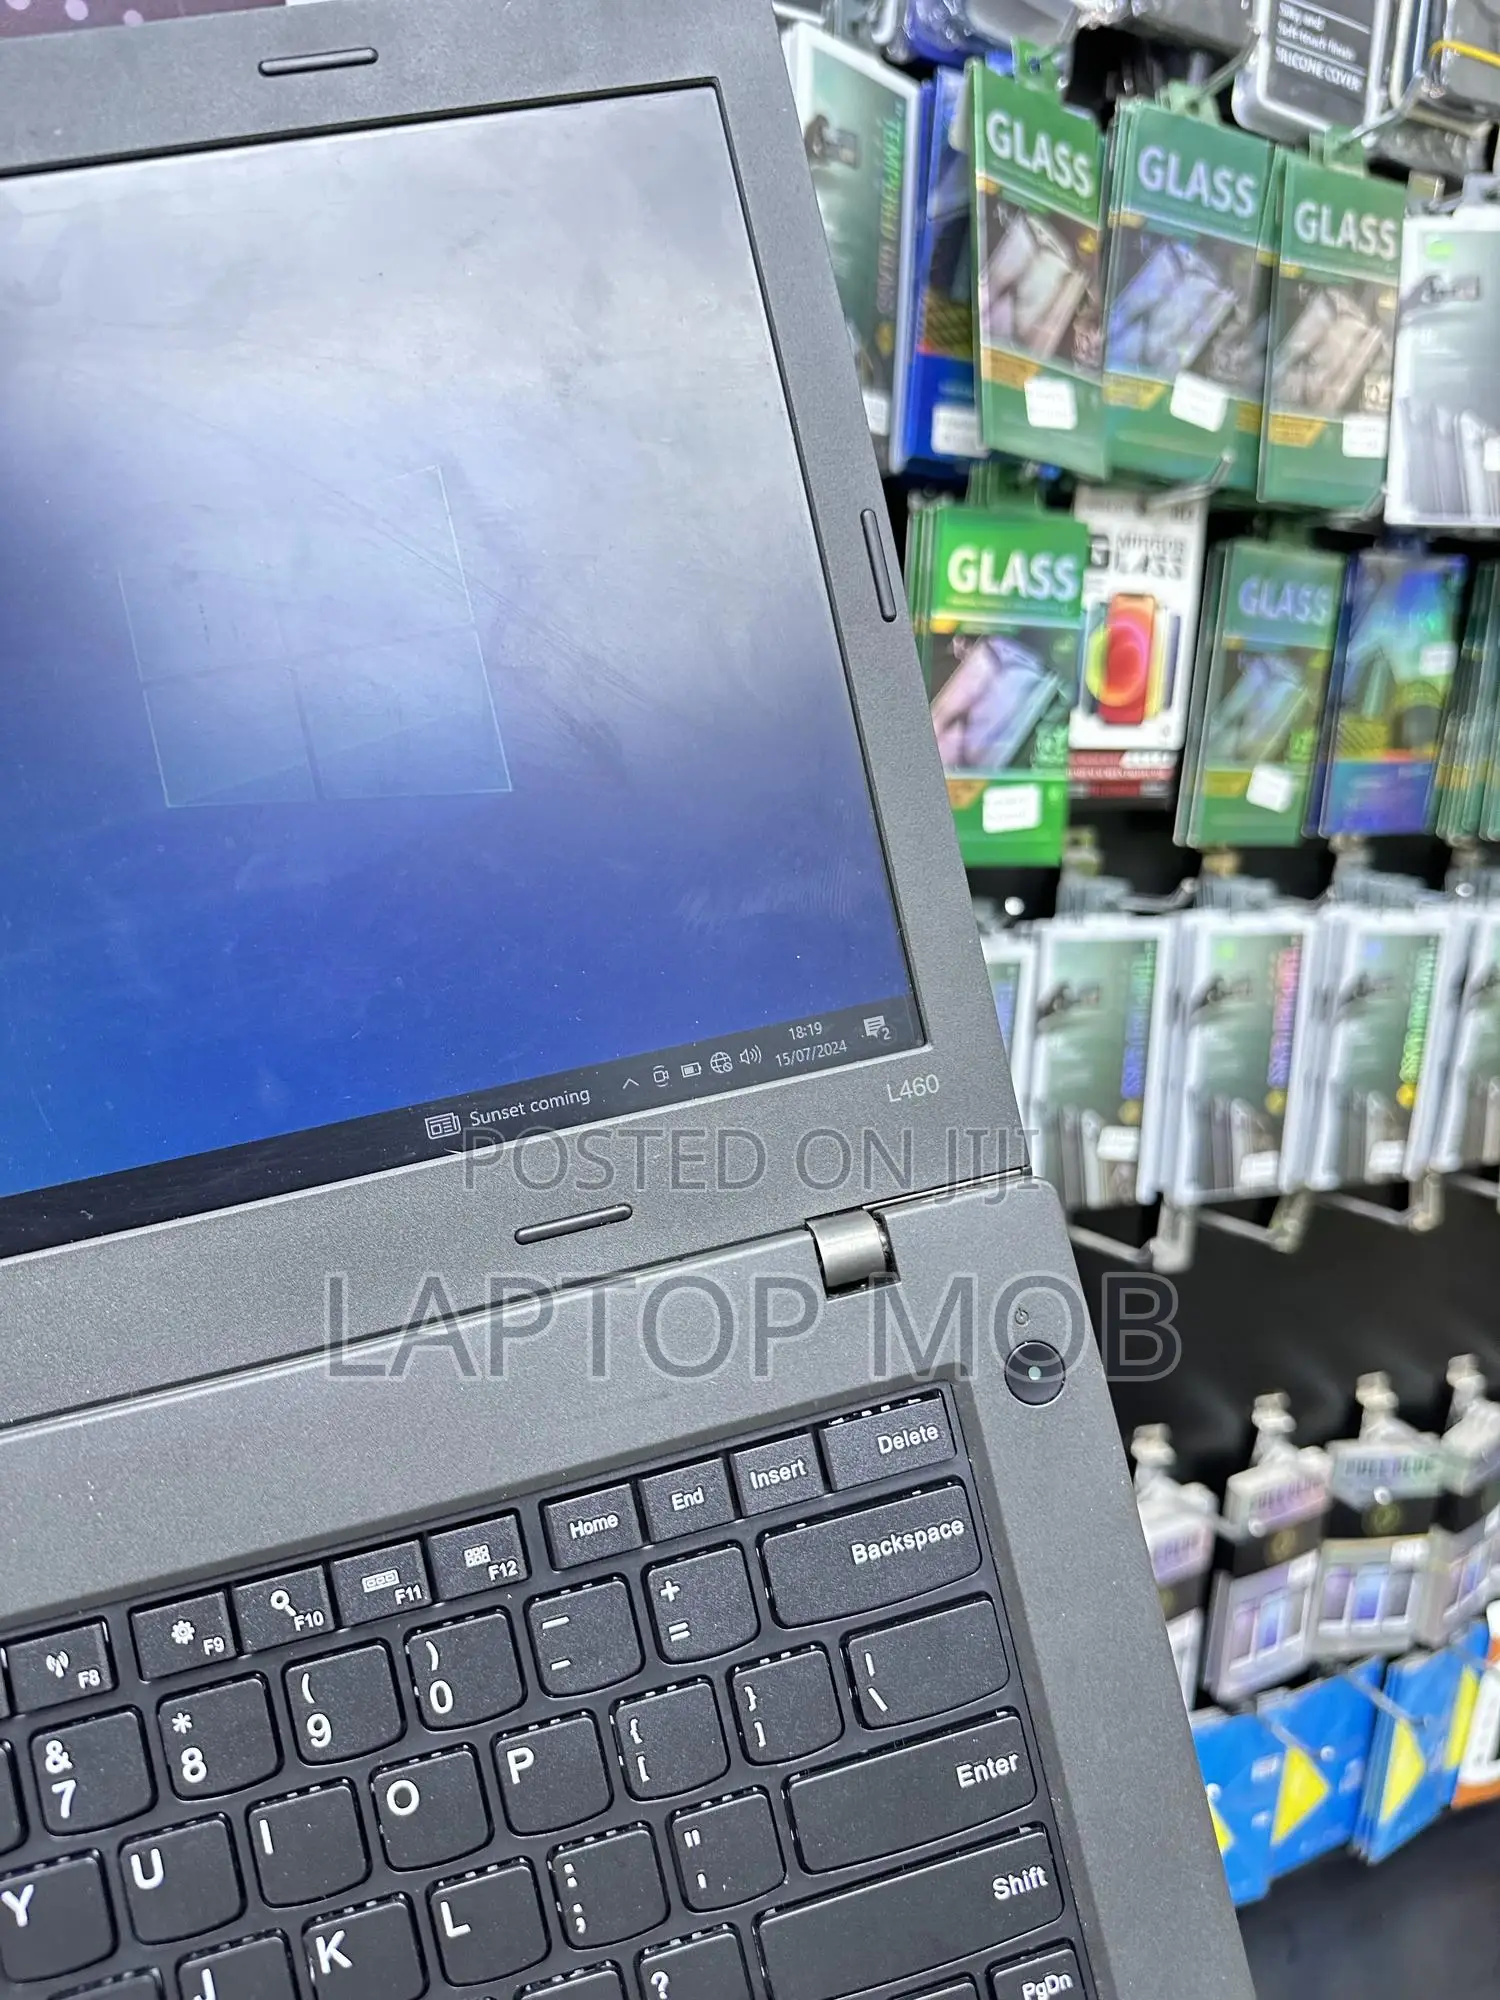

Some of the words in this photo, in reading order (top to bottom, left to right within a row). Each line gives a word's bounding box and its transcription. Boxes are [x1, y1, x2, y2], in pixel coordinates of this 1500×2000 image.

[1276, 46, 1324, 80] SILICONE
[1324, 66, 1363, 93] COVER
[985, 111, 1094, 199] GLASS
[1137, 145, 1258, 218] GLASS
[1293, 199, 1399, 262] GLASS
[946, 545, 1080, 601] GLASS
[1238, 575, 1330, 626] GLASS
[788, 1021, 822, 1041] 18:19
[881, 1027, 892, 1041] 2
[775, 1039, 847, 1067] 15/07/2024
[886, 1073, 940, 1103] L460
[469, 1102, 526, 1127] Sunset
[530, 1089, 591, 1113] coming
[877, 1424, 939, 1455] Delete
[749, 1459, 807, 1490] Insert
[671, 1482, 705, 1511] End
[569, 1510, 619, 1540] Home
[851, 1517, 965, 1565] Backspace
[488, 1559, 519, 1582] F12
[395, 1584, 423, 1605] F11
[294, 1610, 323, 1632] F10
[203, 1636, 225, 1656] F9
[77, 1669, 101, 1689] F8
[429, 1680, 454, 1714] 0
[306, 1713, 332, 1748] 9
[45, 1740, 73, 1774] &
[181, 1747, 207, 1784] 8
[506, 1747, 535, 1785] P
[956, 1753, 1019, 1789] Enter
[51, 1779, 77, 1819] 7
[386, 1779, 420, 1816] O
[259, 1819, 274, 1855] I
[130, 1848, 164, 1890] U
[992, 1866, 1049, 1901] Shift
[1, 1884, 34, 1927] Y
[440, 1901, 471, 1938] L
[316, 1930, 352, 1975] K
[193, 1968, 216, 2000] J
[650, 1971, 669, 2000] ?
[1021, 1974, 1073, 2000] PgDn
